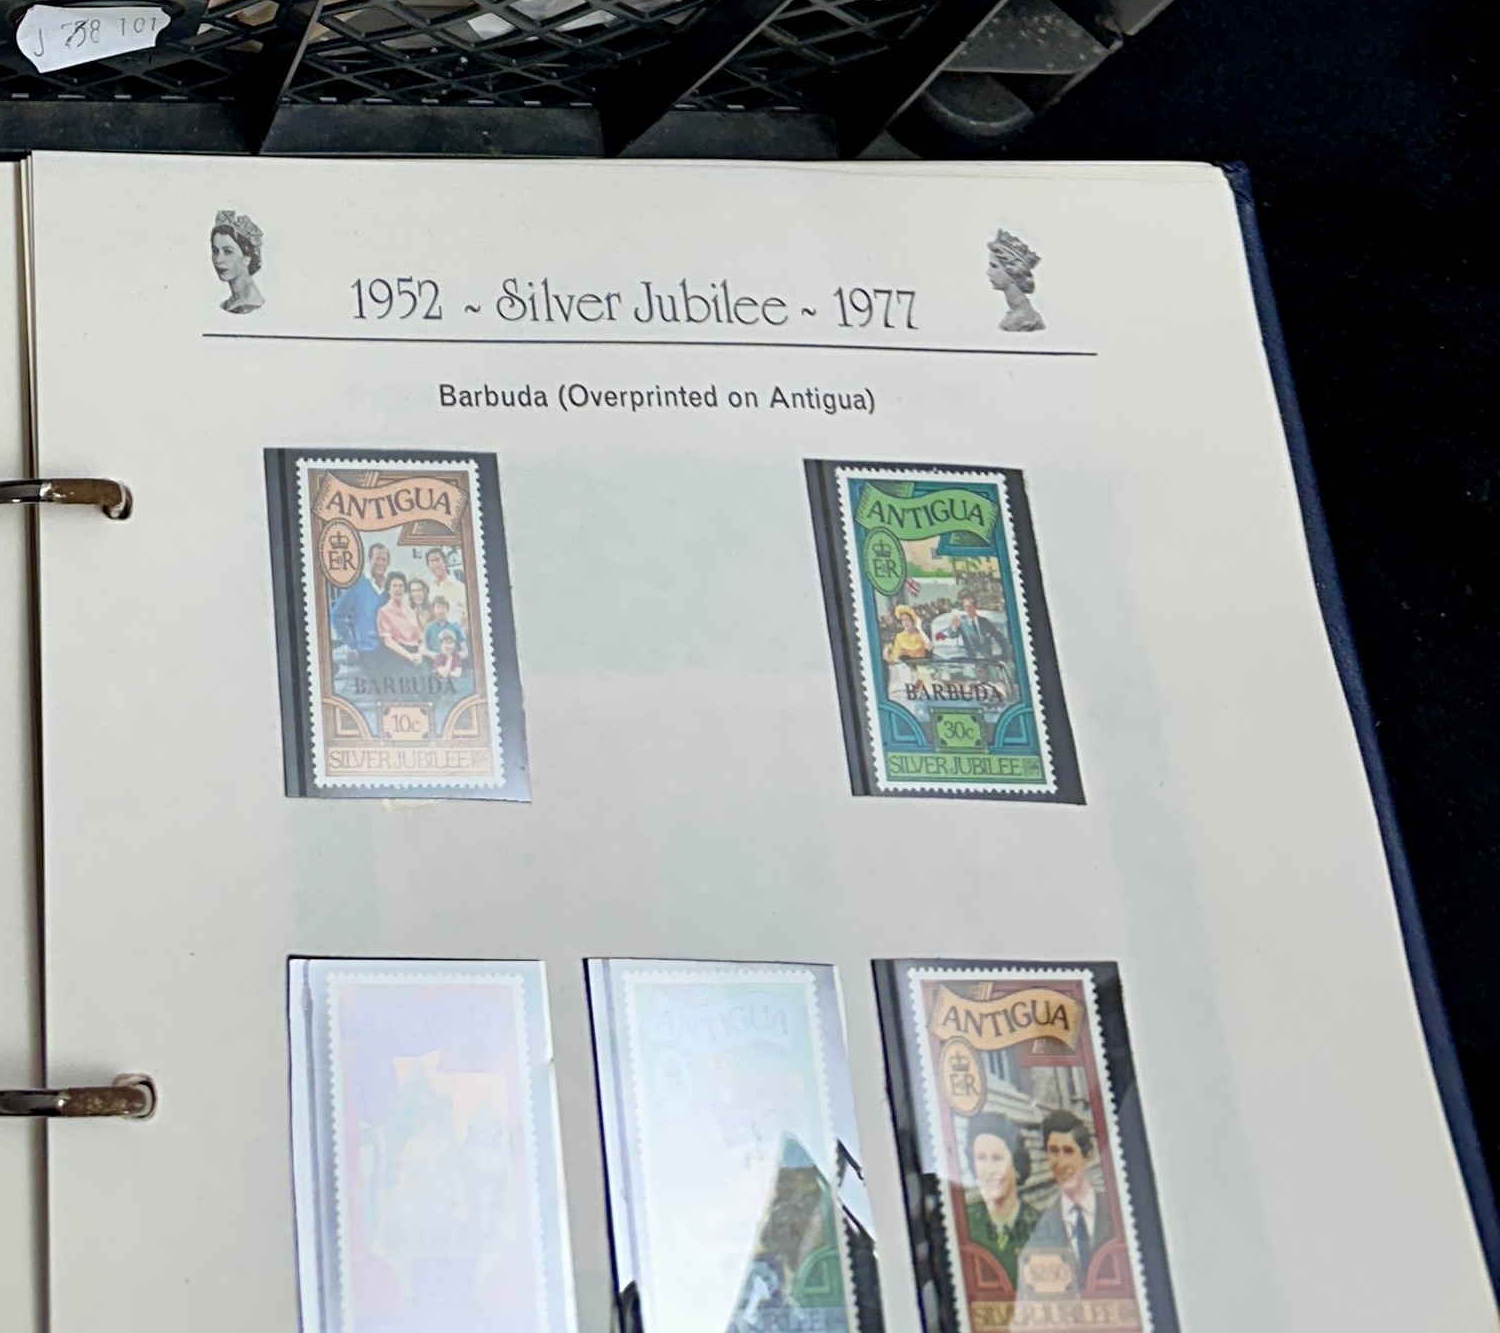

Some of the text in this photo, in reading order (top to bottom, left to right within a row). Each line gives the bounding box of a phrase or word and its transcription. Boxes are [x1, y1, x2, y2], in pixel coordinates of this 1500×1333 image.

[351, 278, 920, 329] 1952 Silver Jubilee 1977
[439, 383, 876, 416] Barbuda (Overprinted on Antigua)
[324, 486, 453, 521] ANTIGUA
[865, 497, 987, 529] ANTIGUA
[354, 674, 458, 698] BARBUDA
[903, 683, 1005, 705] BARBUDA
[390, 711, 421, 736] 10c
[943, 718, 977, 742] 30c
[329, 749, 469, 774] SILVER JUBILEE
[888, 755, 1022, 779] SILVER JUBILEE
[941, 999, 1072, 1038] ANTIGUA
